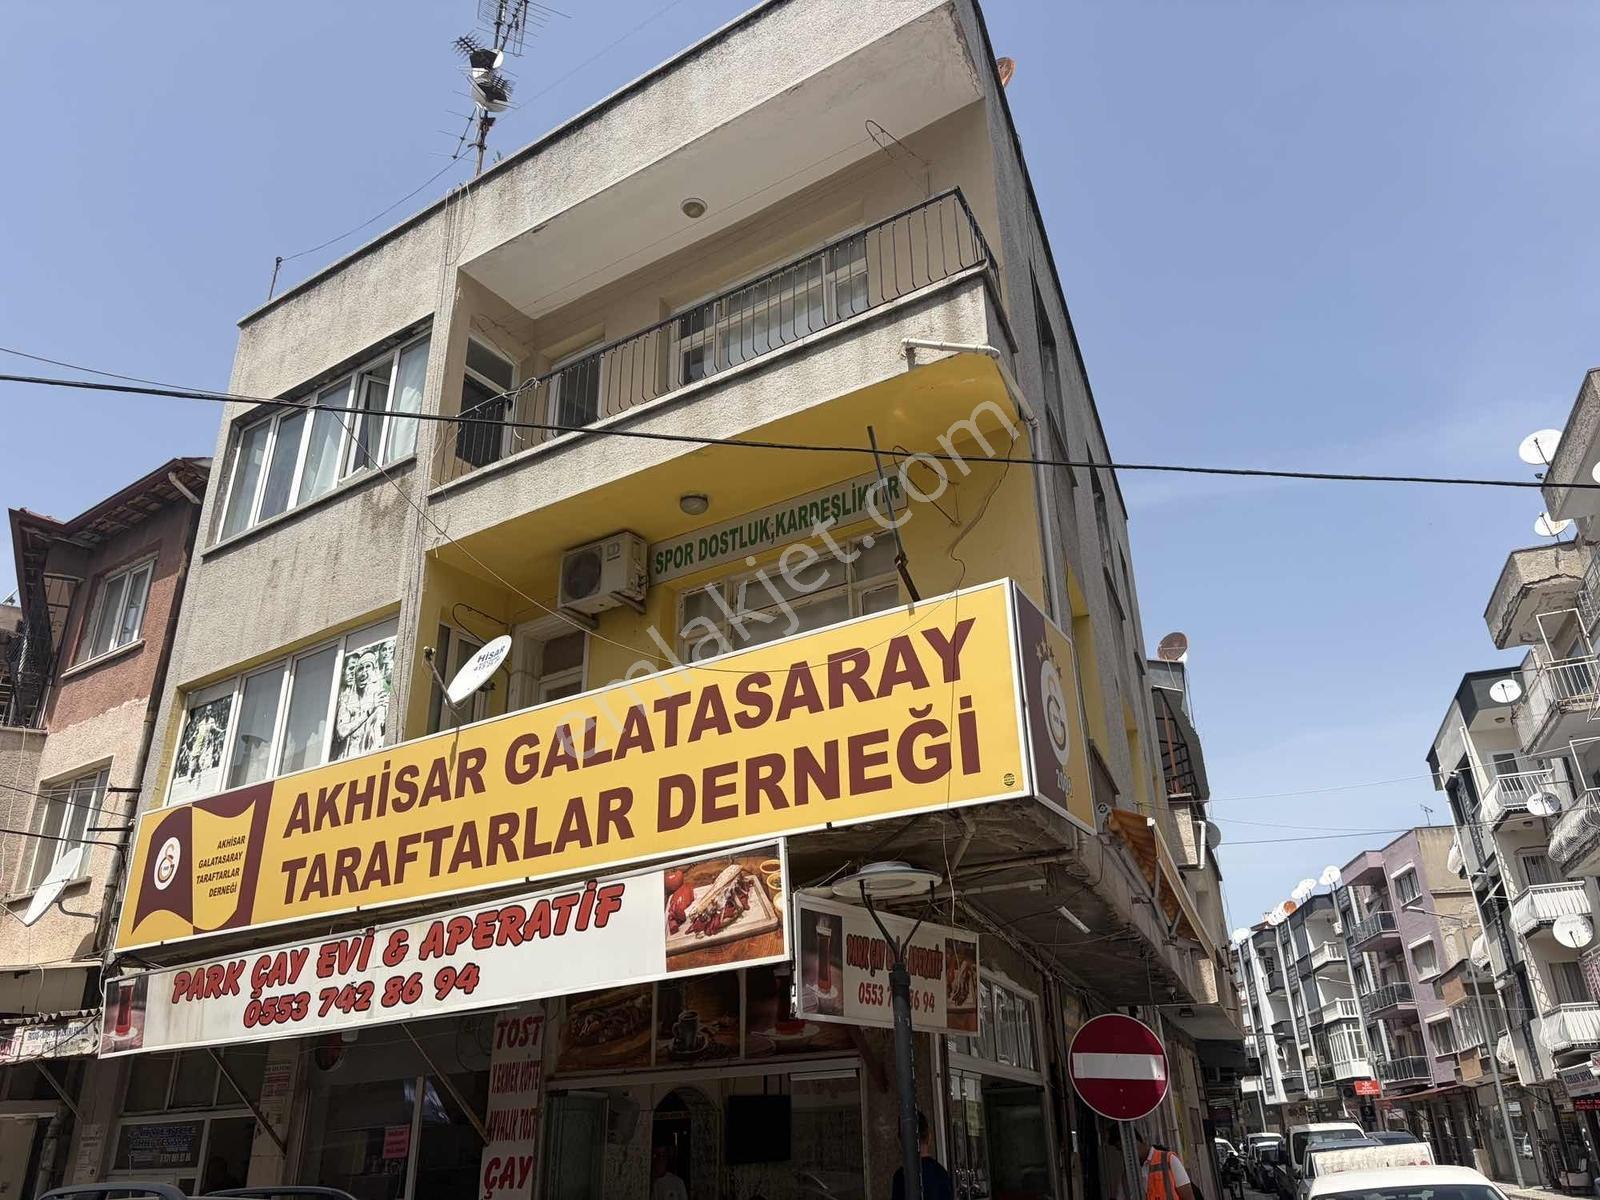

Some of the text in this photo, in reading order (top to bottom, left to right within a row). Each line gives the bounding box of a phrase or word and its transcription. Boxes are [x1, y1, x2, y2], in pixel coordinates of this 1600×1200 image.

[654, 540, 694, 576] SPOR
[282, 617, 977, 839] AKHİSAR GALATASARAY
[280, 695, 982, 905] TARAFTARLAR DERNEĞİ
[198, 851, 243, 868] GALATASARAY
[217, 836, 245, 849] AKHİSAR
[197, 868, 240, 884] TARAFTARLAR
[208, 882, 237, 896] DERNEĞİ
[171, 878, 626, 1004] PARK ÇAY EVİ & APERATİF
[243, 961, 480, 1029] 0553 742 86 94
[858, 981, 884, 1007] 0553
[922, 991, 936, 1014] 94
[495, 1015, 544, 1050] TOST
[483, 1155, 534, 1200] ÇAY
